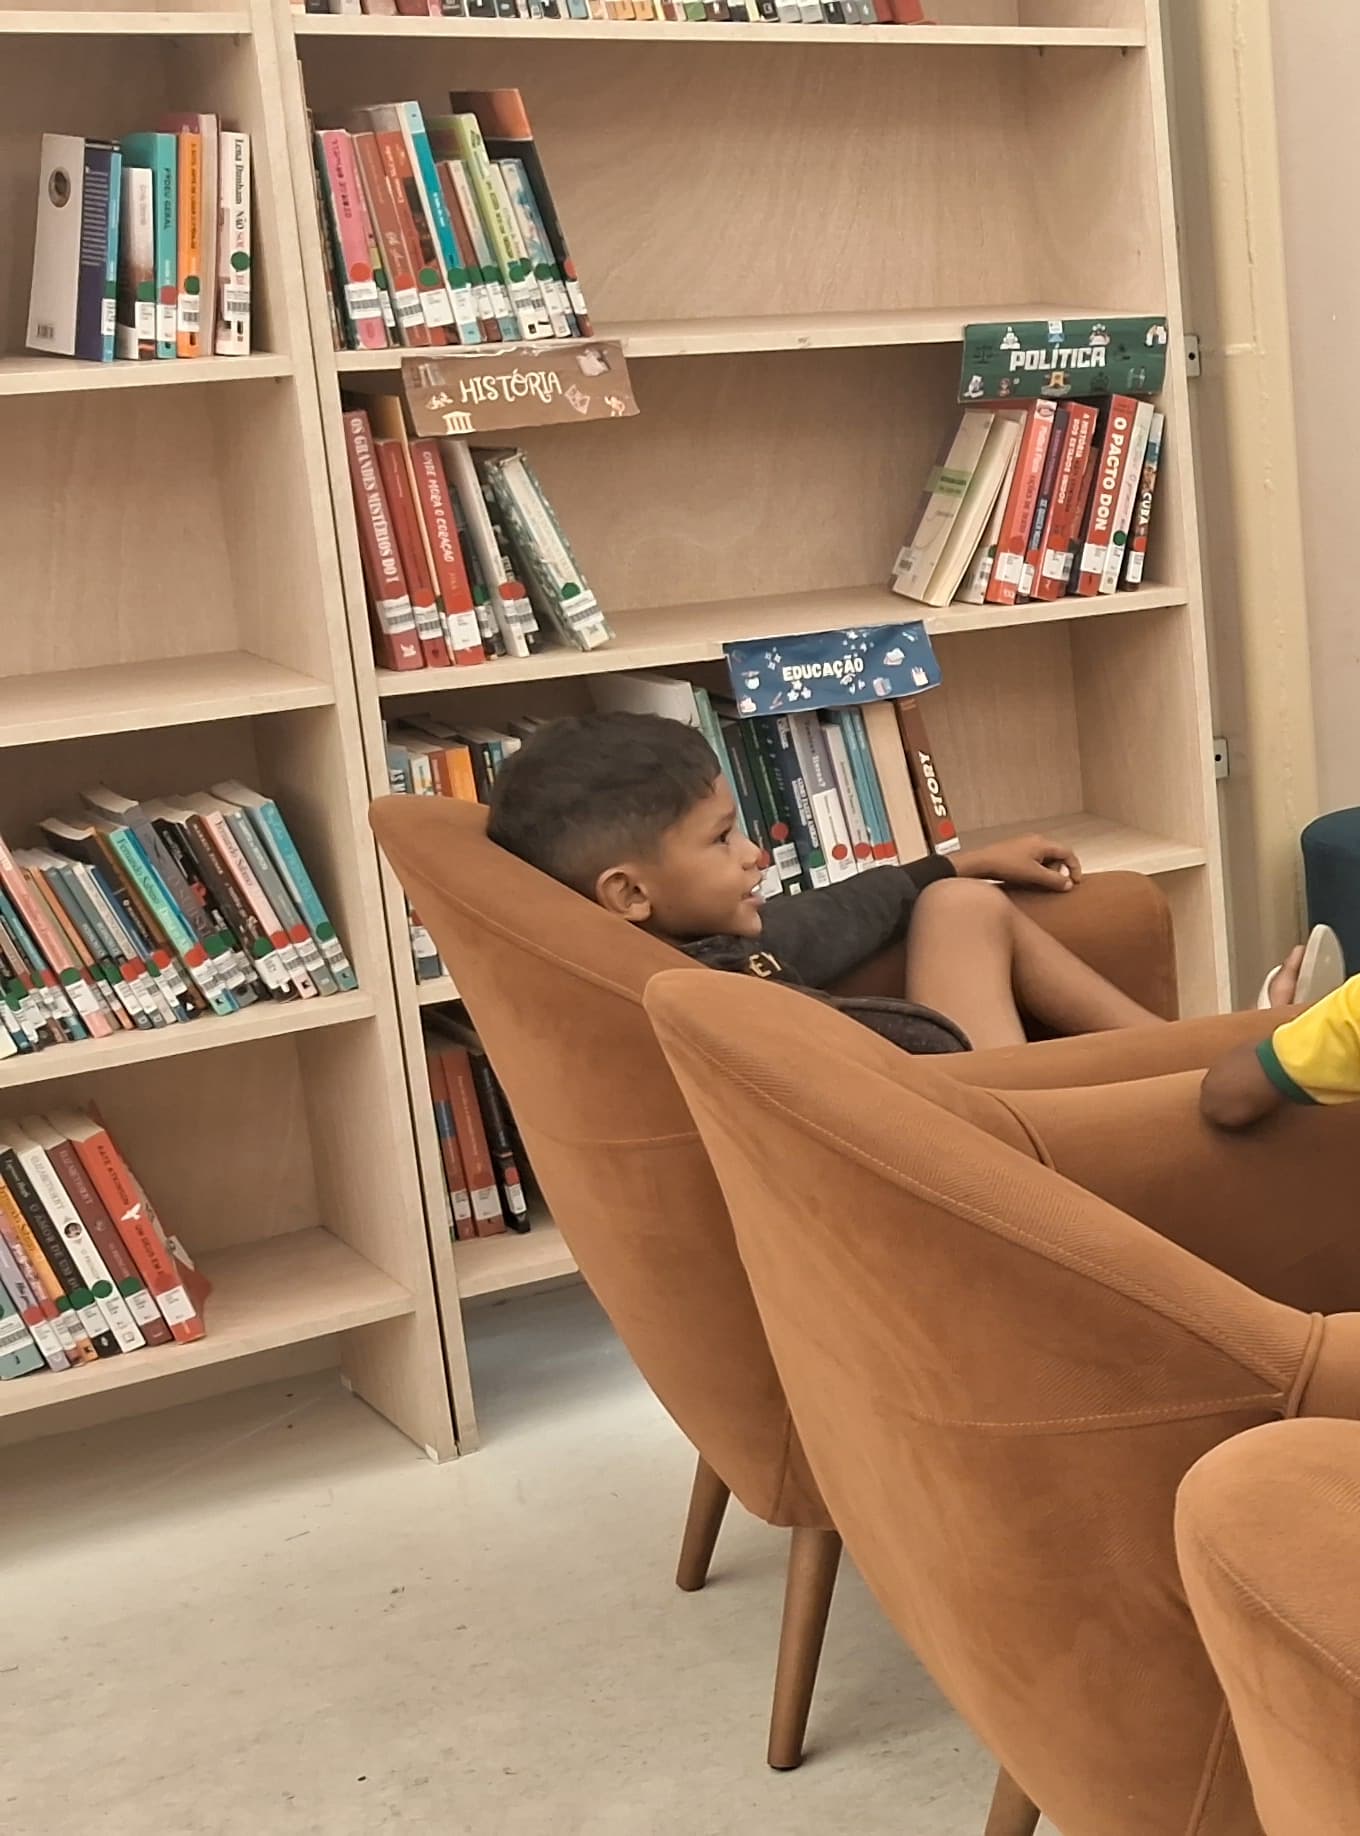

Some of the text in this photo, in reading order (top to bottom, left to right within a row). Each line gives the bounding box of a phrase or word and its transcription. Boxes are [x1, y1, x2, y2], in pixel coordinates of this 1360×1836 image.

[233, 139, 243, 161] Lena
[232, 165, 243, 204] Dunham
[163, 200, 171, 230] GERAL
[1009, 344, 1106, 371] POLÍTICA
[459, 368, 562, 404] HISTÓRIA
[1075, 419, 1089, 458] HISTÓRIA
[1058, 418, 1080, 504] DOS ESTADOS UNIDOS
[1094, 416, 1127, 531] O PACTO DON
[351, 418, 396, 575] OS GRANDES MISTÉRIOS DO
[422, 451, 453, 562] ONDE MORA O CORAÇÃO
[1138, 492, 1152, 525] CUBA
[782, 655, 864, 682] EDUCAÇÃO
[918, 751, 946, 817] STORY
[117, 837, 143, 876] Fernando
[35, 1213, 54, 1241] AMOR
